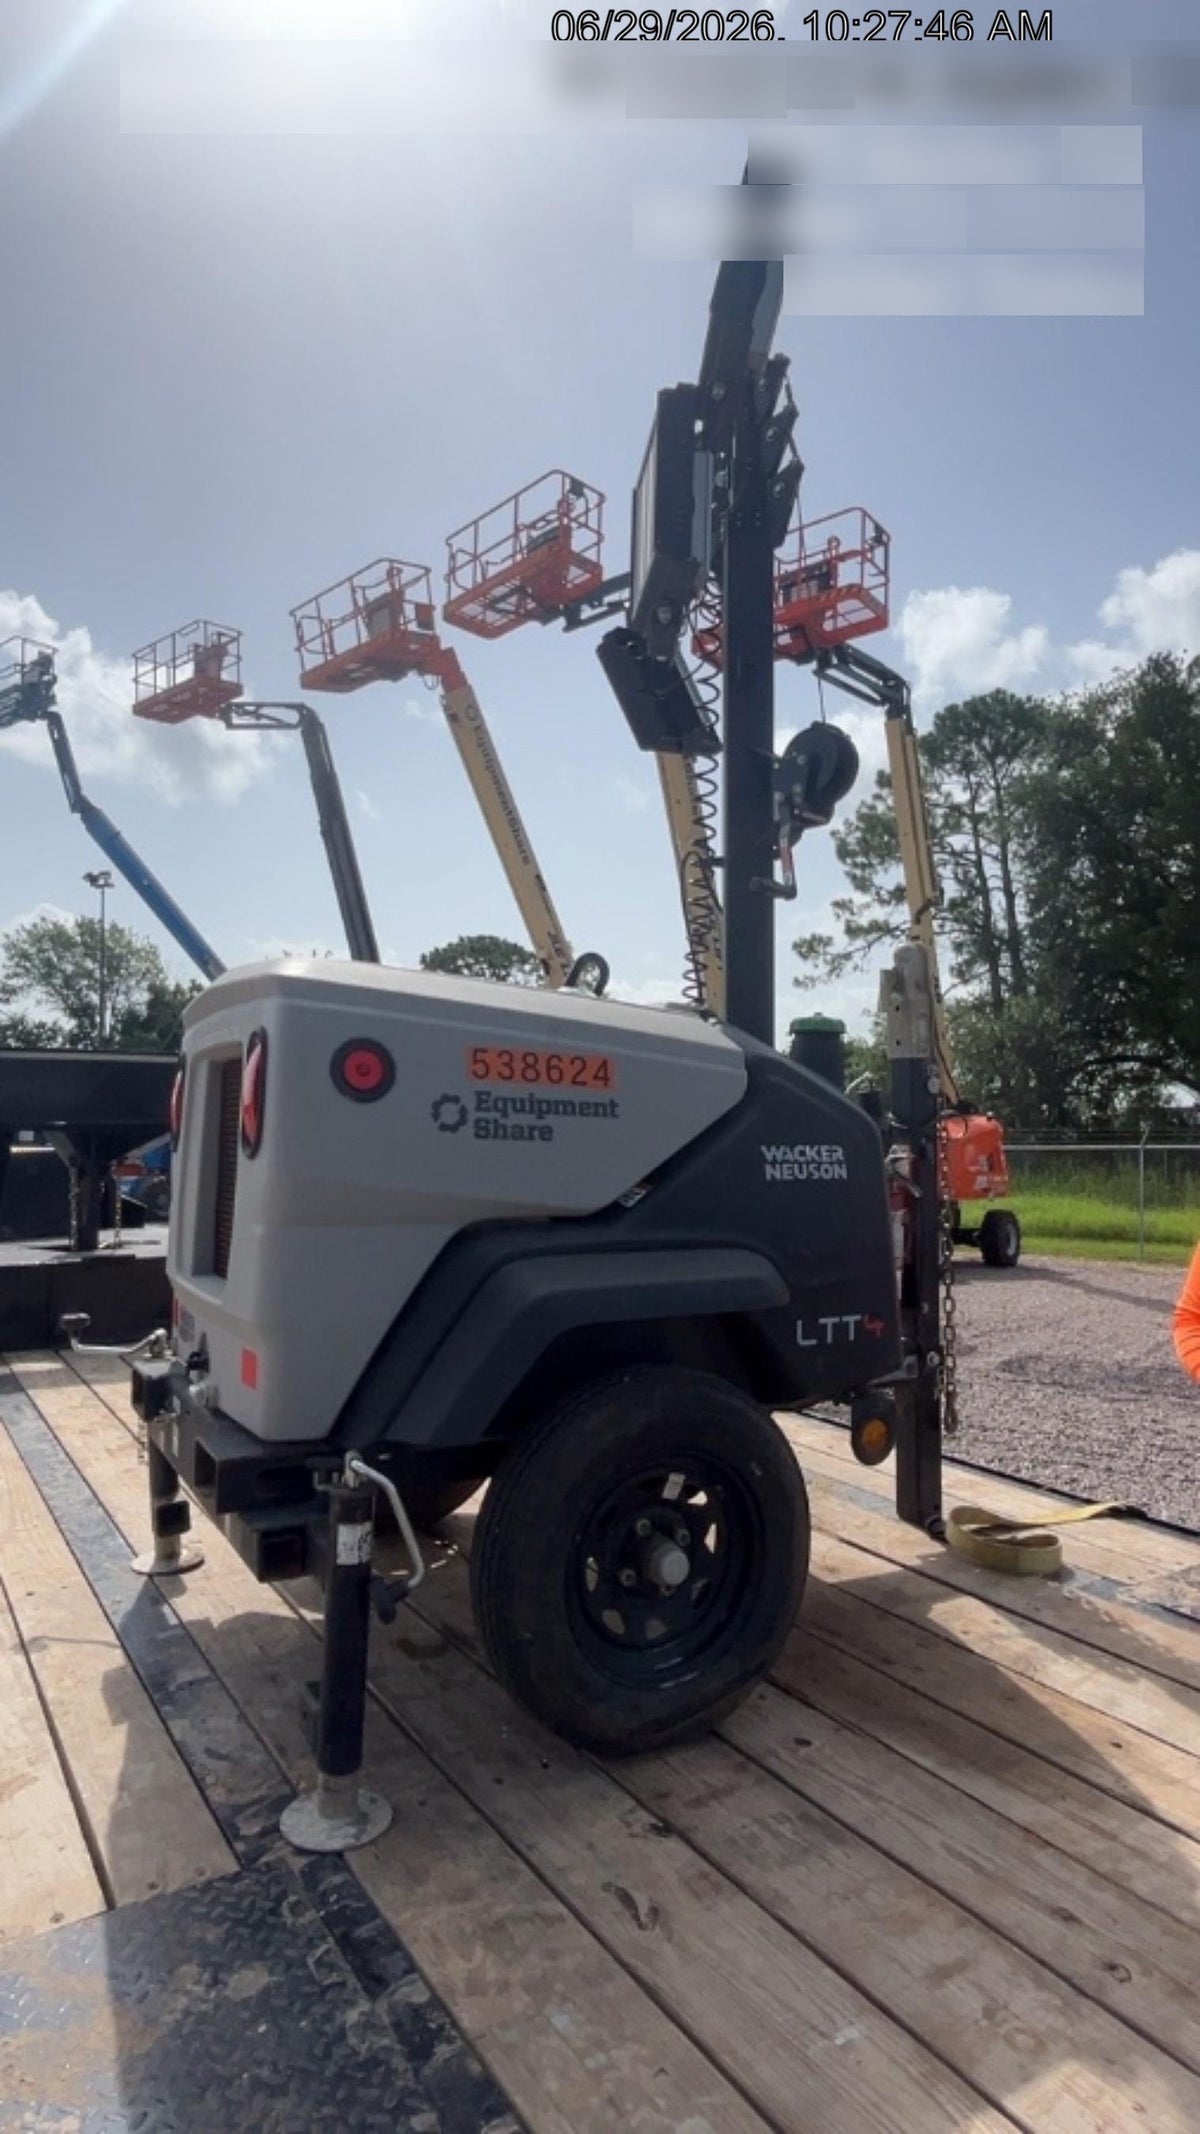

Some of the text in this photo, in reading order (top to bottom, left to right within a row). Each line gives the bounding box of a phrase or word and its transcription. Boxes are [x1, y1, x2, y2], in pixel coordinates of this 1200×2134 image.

[471, 1047, 611, 1087] 538624
[474, 1090, 620, 1119] Equipment
[473, 1117, 554, 1142] Share
[760, 1144, 844, 1163] WACKER
[764, 1163, 848, 1181] NEUSON
[796, 1314, 885, 1346] LTT4
